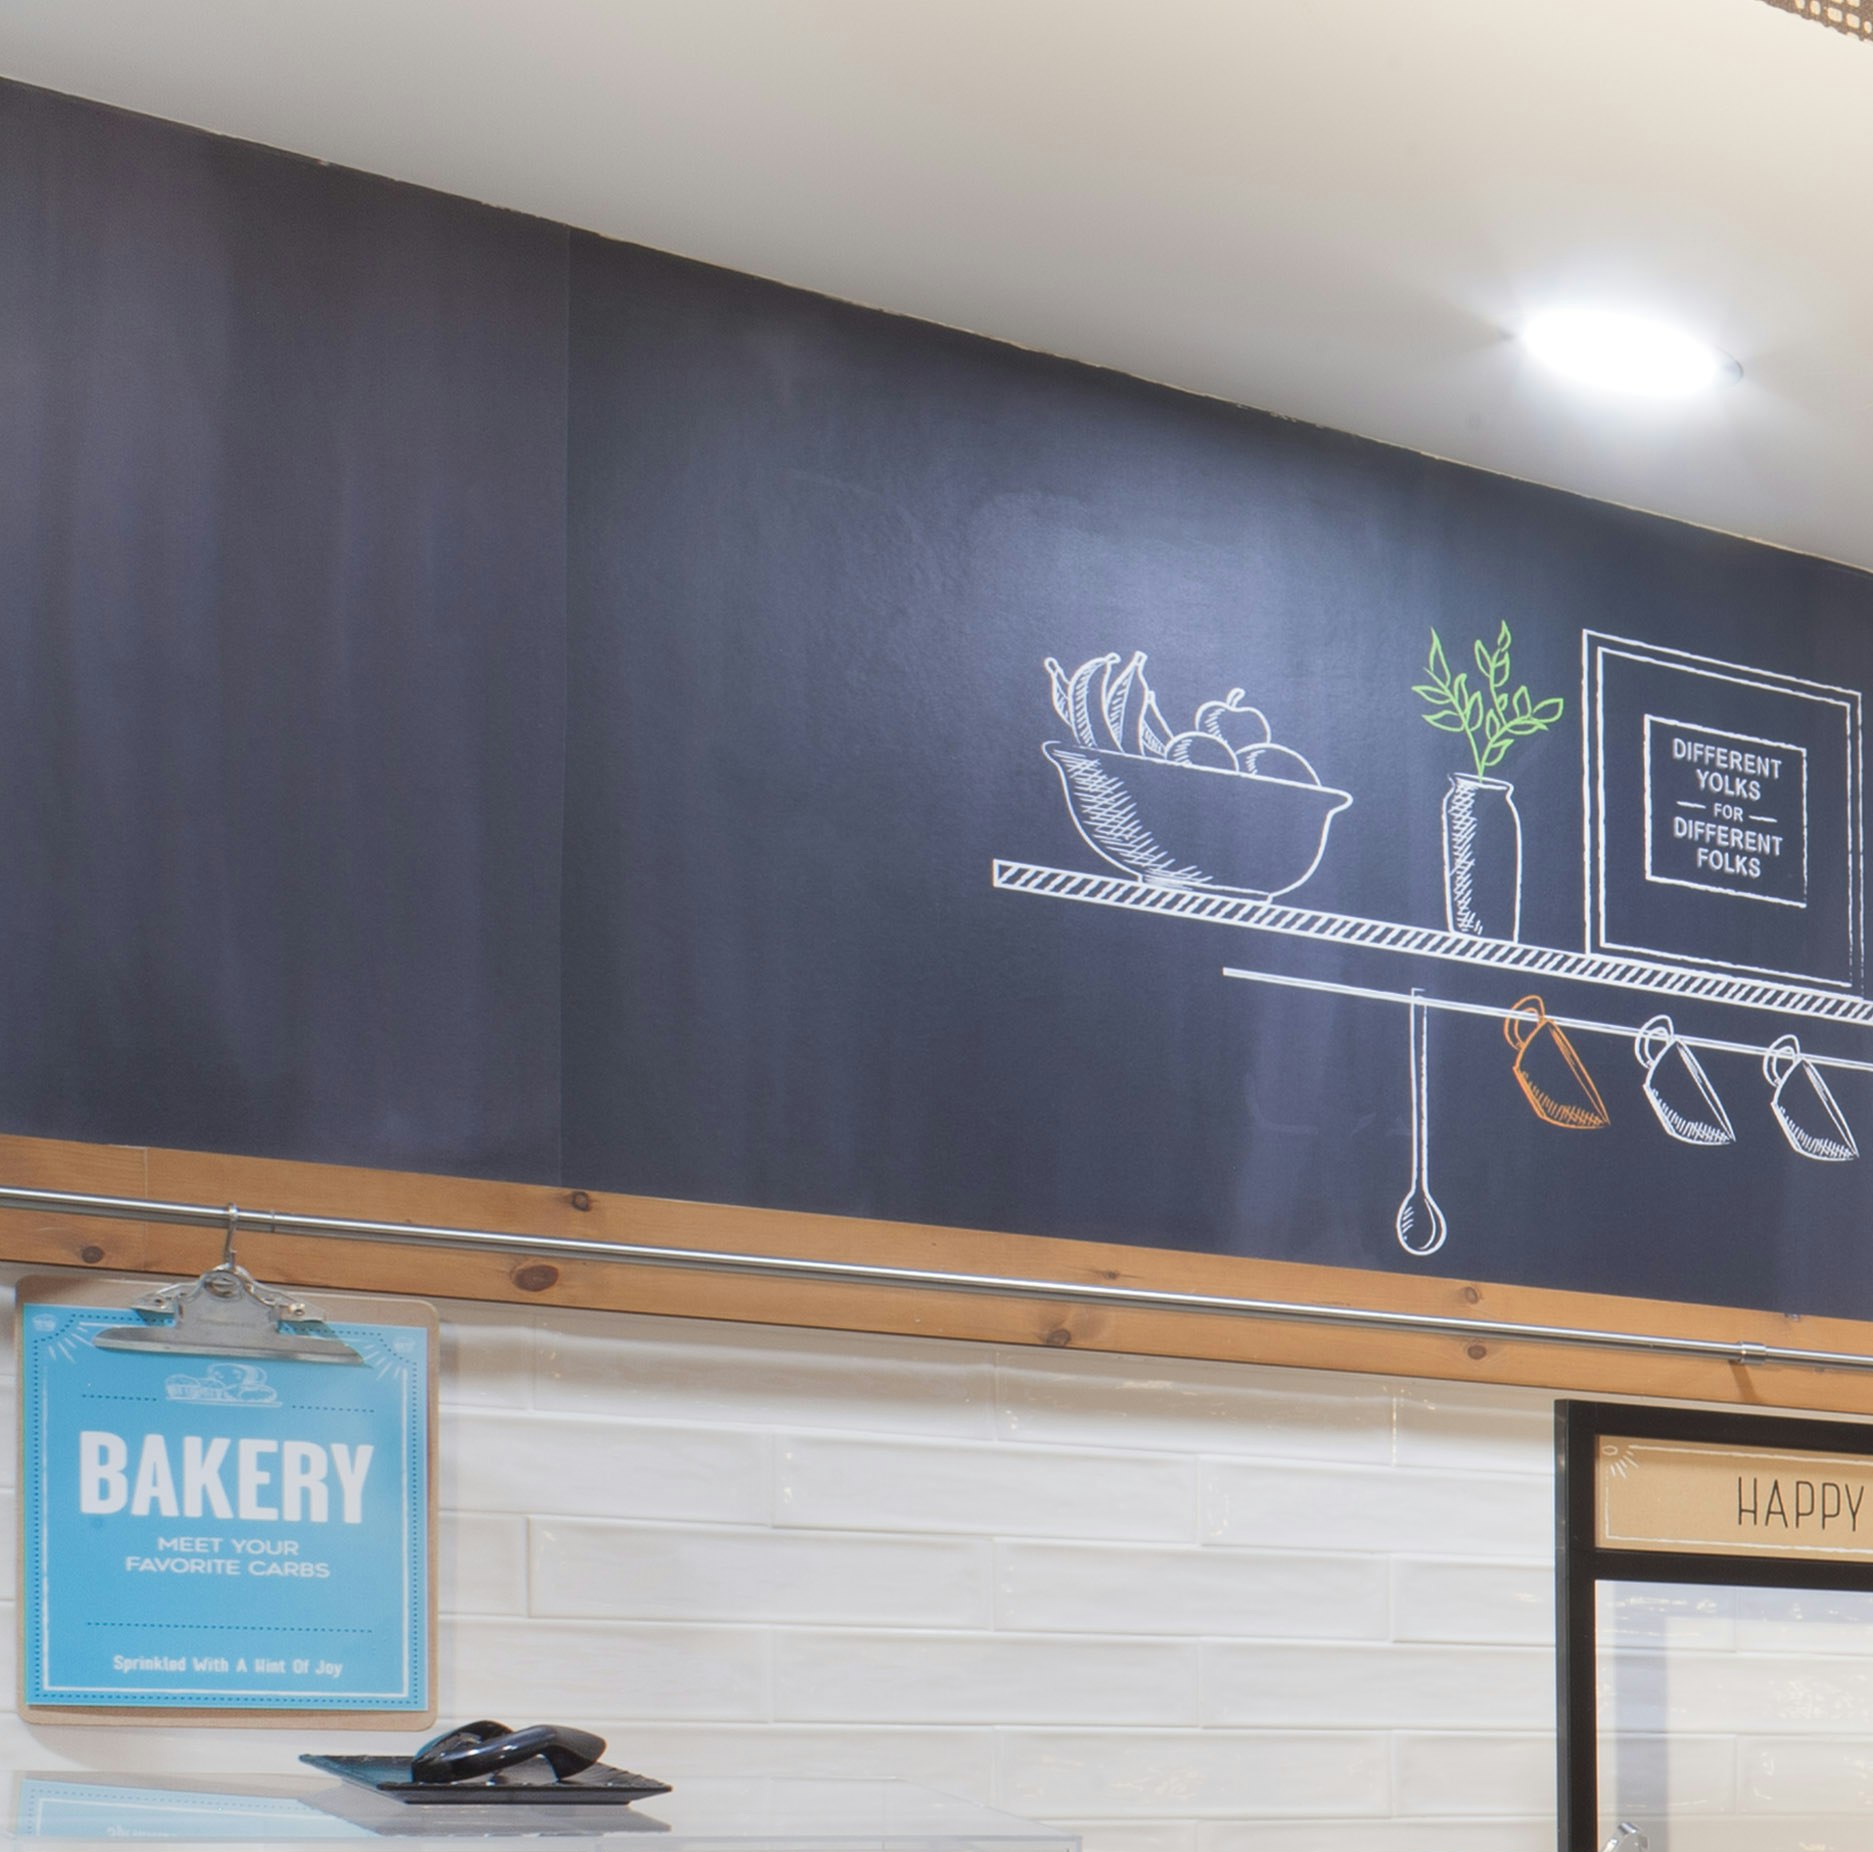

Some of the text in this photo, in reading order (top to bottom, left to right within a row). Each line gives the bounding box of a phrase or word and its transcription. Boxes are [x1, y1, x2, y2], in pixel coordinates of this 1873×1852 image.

[1672, 738, 1782, 779] DIFFERENT
[1696, 769, 1761, 801] YOLKS
[1713, 803, 1744, 822] FOR
[1673, 817, 1783, 856] DIFFERENT
[1697, 847, 1761, 878] FOLKS
[79, 1431, 374, 1523] BAKERY
[1737, 1476, 1865, 1532] HAPPY
[157, 1537, 299, 1556] MEET YOUR
[125, 1556, 331, 1578] FAVORITE CARBS
[113, 1655, 343, 1678] Sprinkled With A Hint Of Joy
